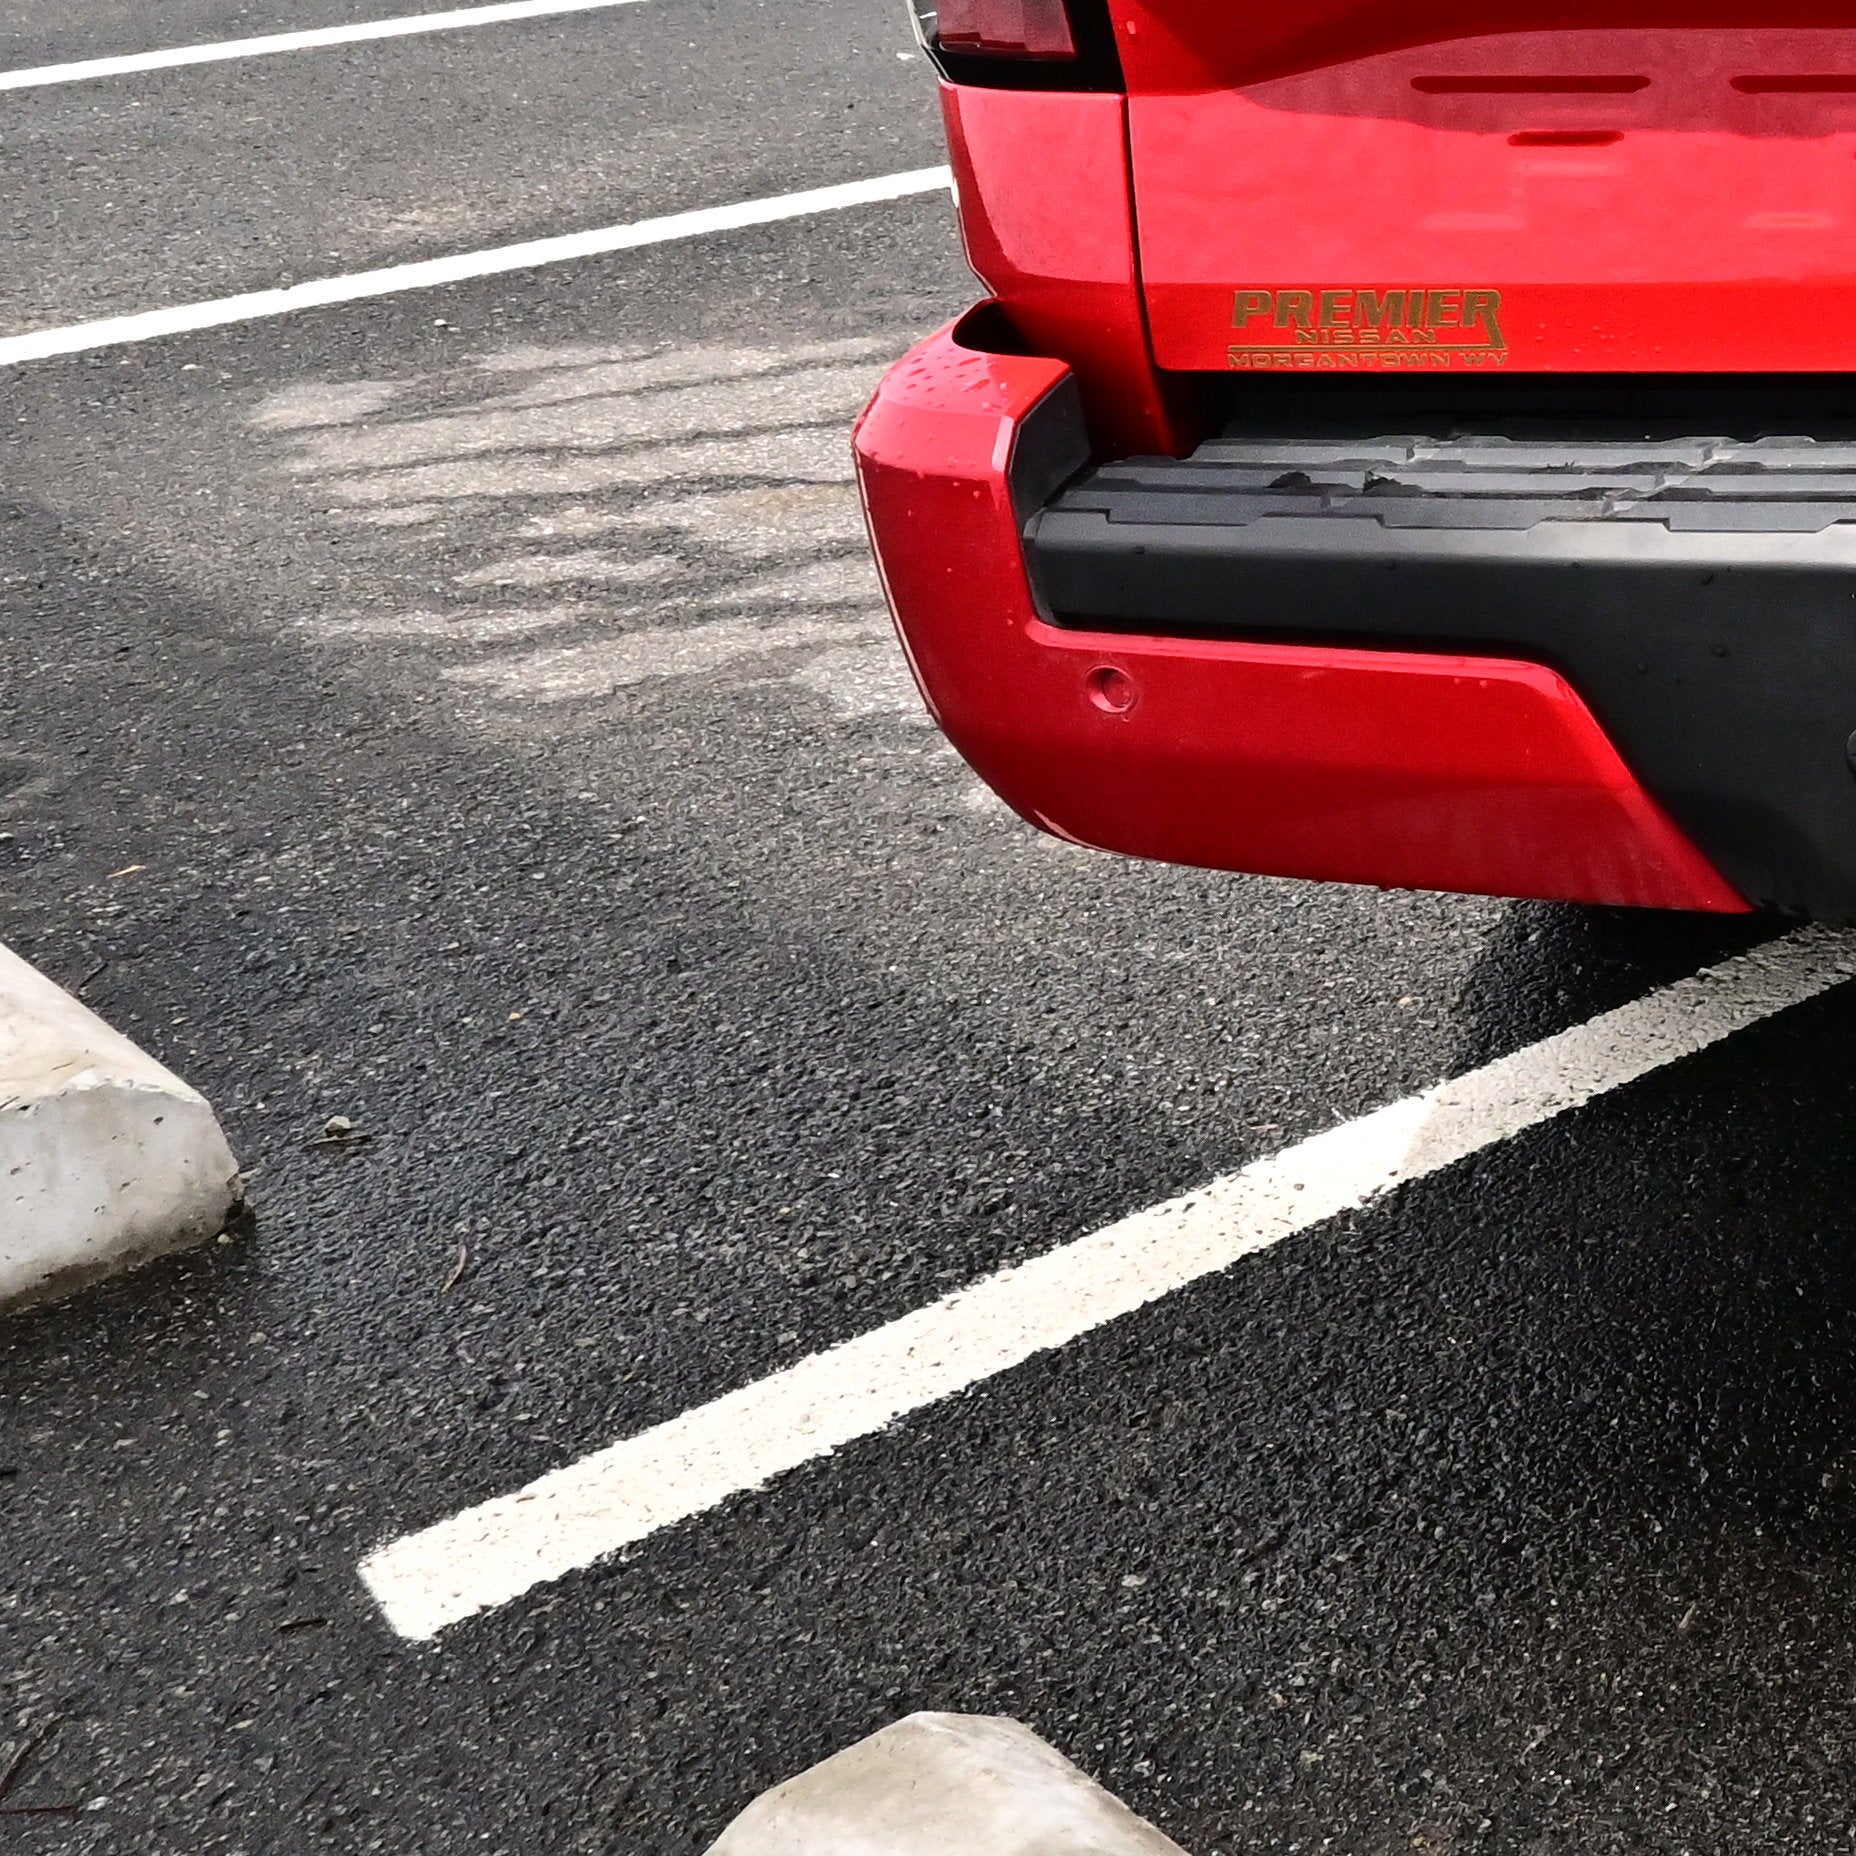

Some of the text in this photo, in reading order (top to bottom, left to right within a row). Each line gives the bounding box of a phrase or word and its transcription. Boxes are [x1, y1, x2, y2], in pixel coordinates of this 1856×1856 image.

[1231, 289, 1506, 349] PREMIER
[1294, 329, 1438, 345] NISSAN
[1227, 352, 1450, 369] MORGANTOWN
